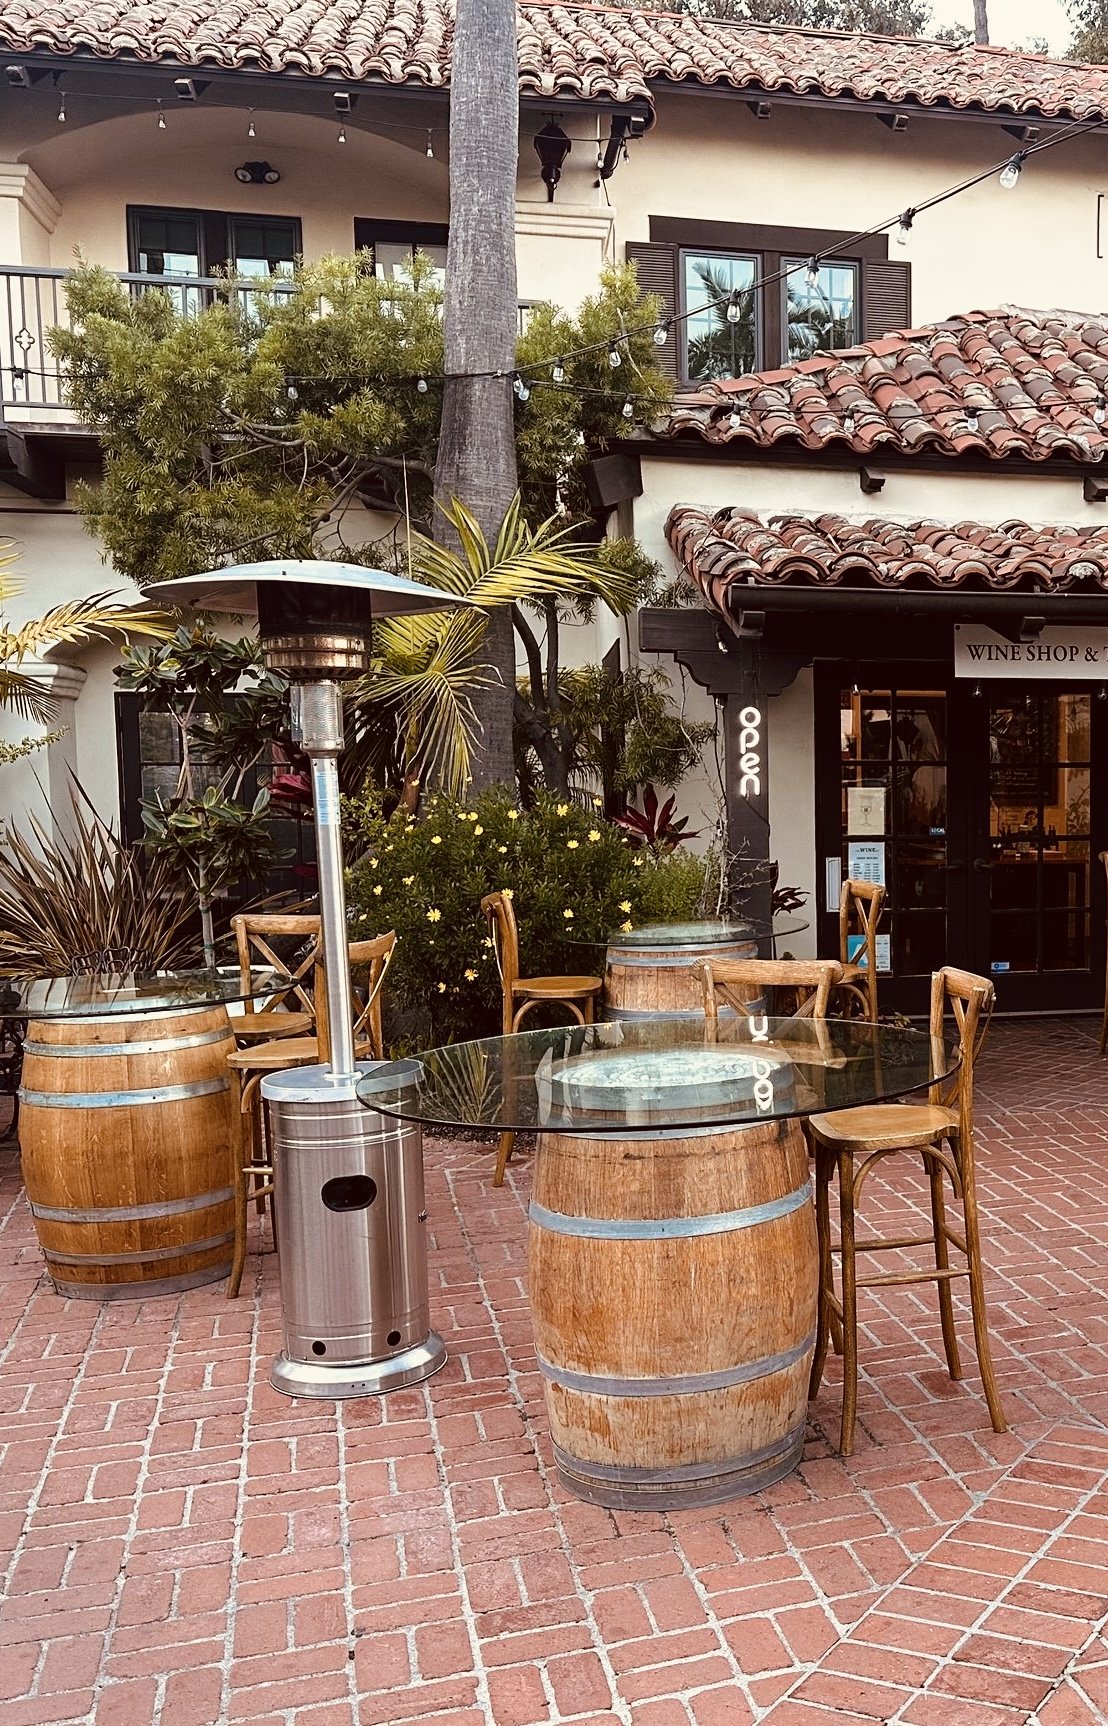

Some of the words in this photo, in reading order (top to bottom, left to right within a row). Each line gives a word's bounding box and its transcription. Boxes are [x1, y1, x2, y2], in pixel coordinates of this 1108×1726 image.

[966, 643, 1022, 662] WINE
[1026, 644, 1079, 663] SHOP
[1084, 647, 1099, 663] &
[740, 706, 761, 796] open
